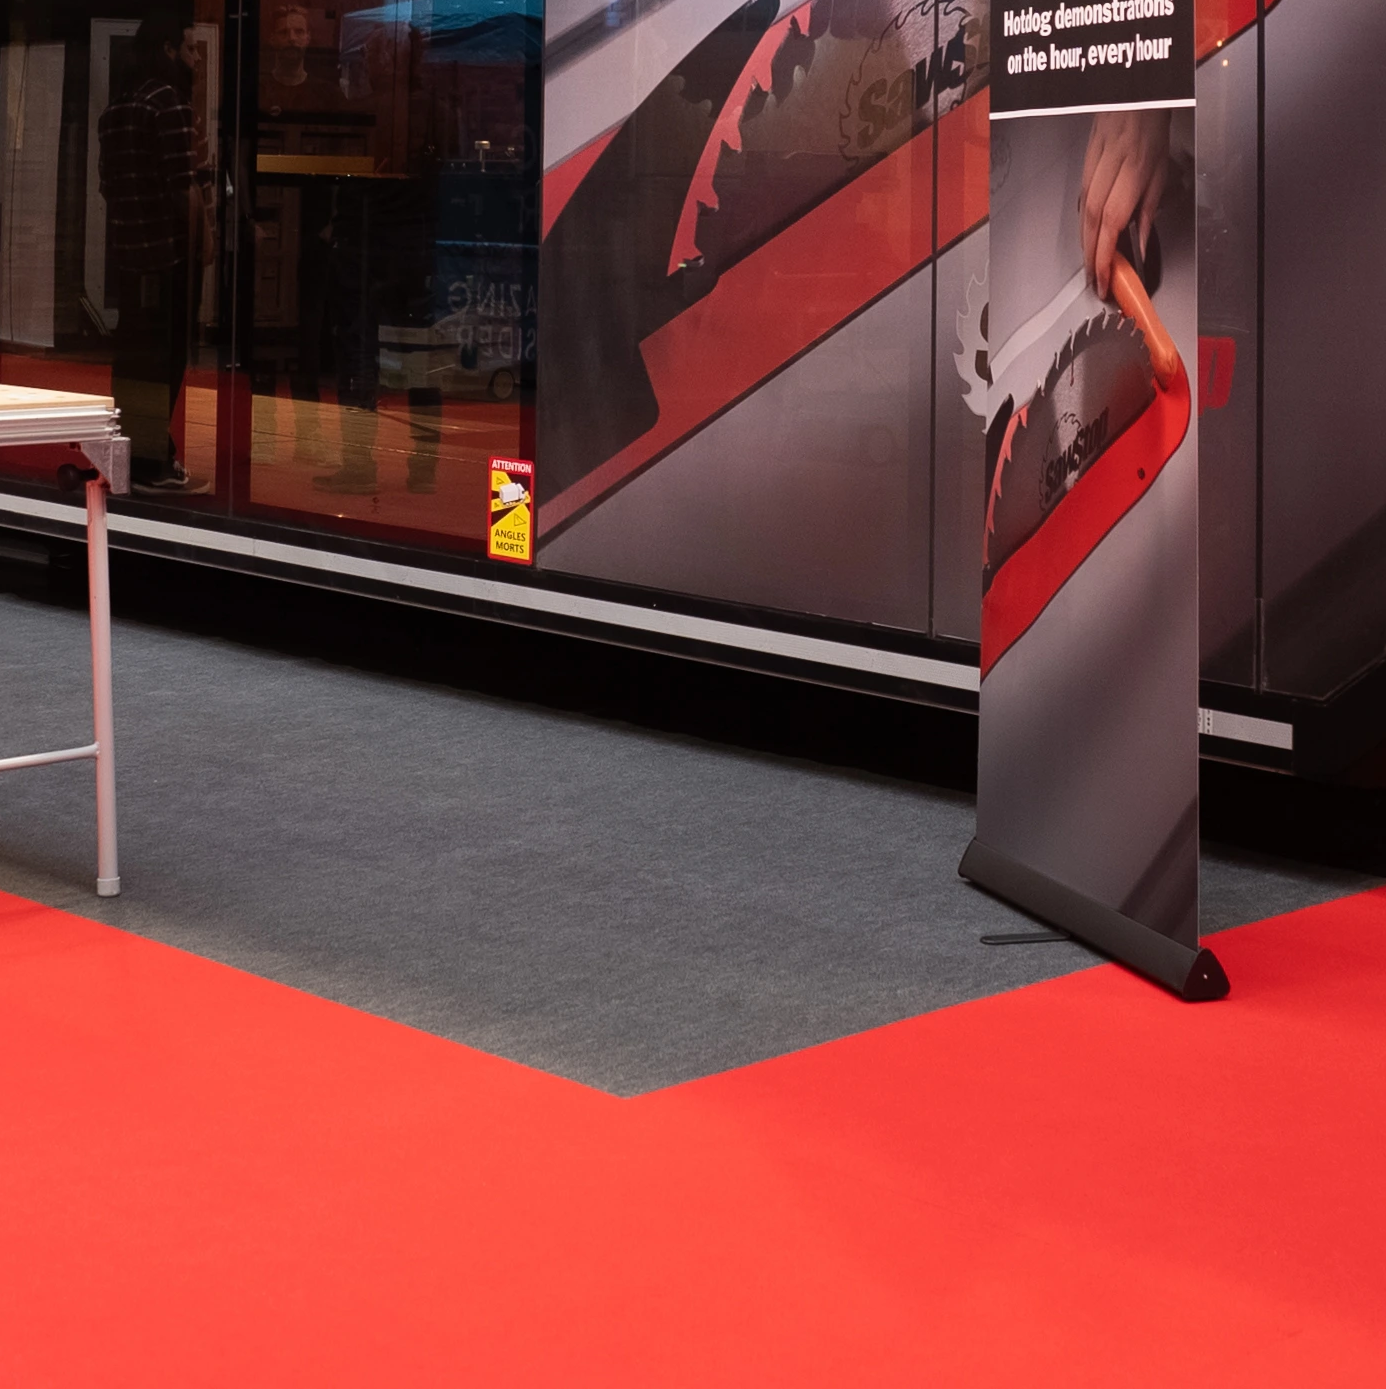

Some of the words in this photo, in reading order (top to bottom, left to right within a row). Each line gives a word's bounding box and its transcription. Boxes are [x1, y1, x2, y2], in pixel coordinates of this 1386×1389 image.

[1003, 7, 1052, 37] Hotdog
[1007, 54, 1022, 74] on
[1023, 48, 1047, 73] the
[1050, 44, 1085, 72] hour,
[1088, 41, 1135, 68] every
[1136, 34, 1172, 62] hour
[492, 459, 531, 473] ATTENTION
[494, 528, 526, 542] ANGLES
[496, 541, 524, 553] MORTS
